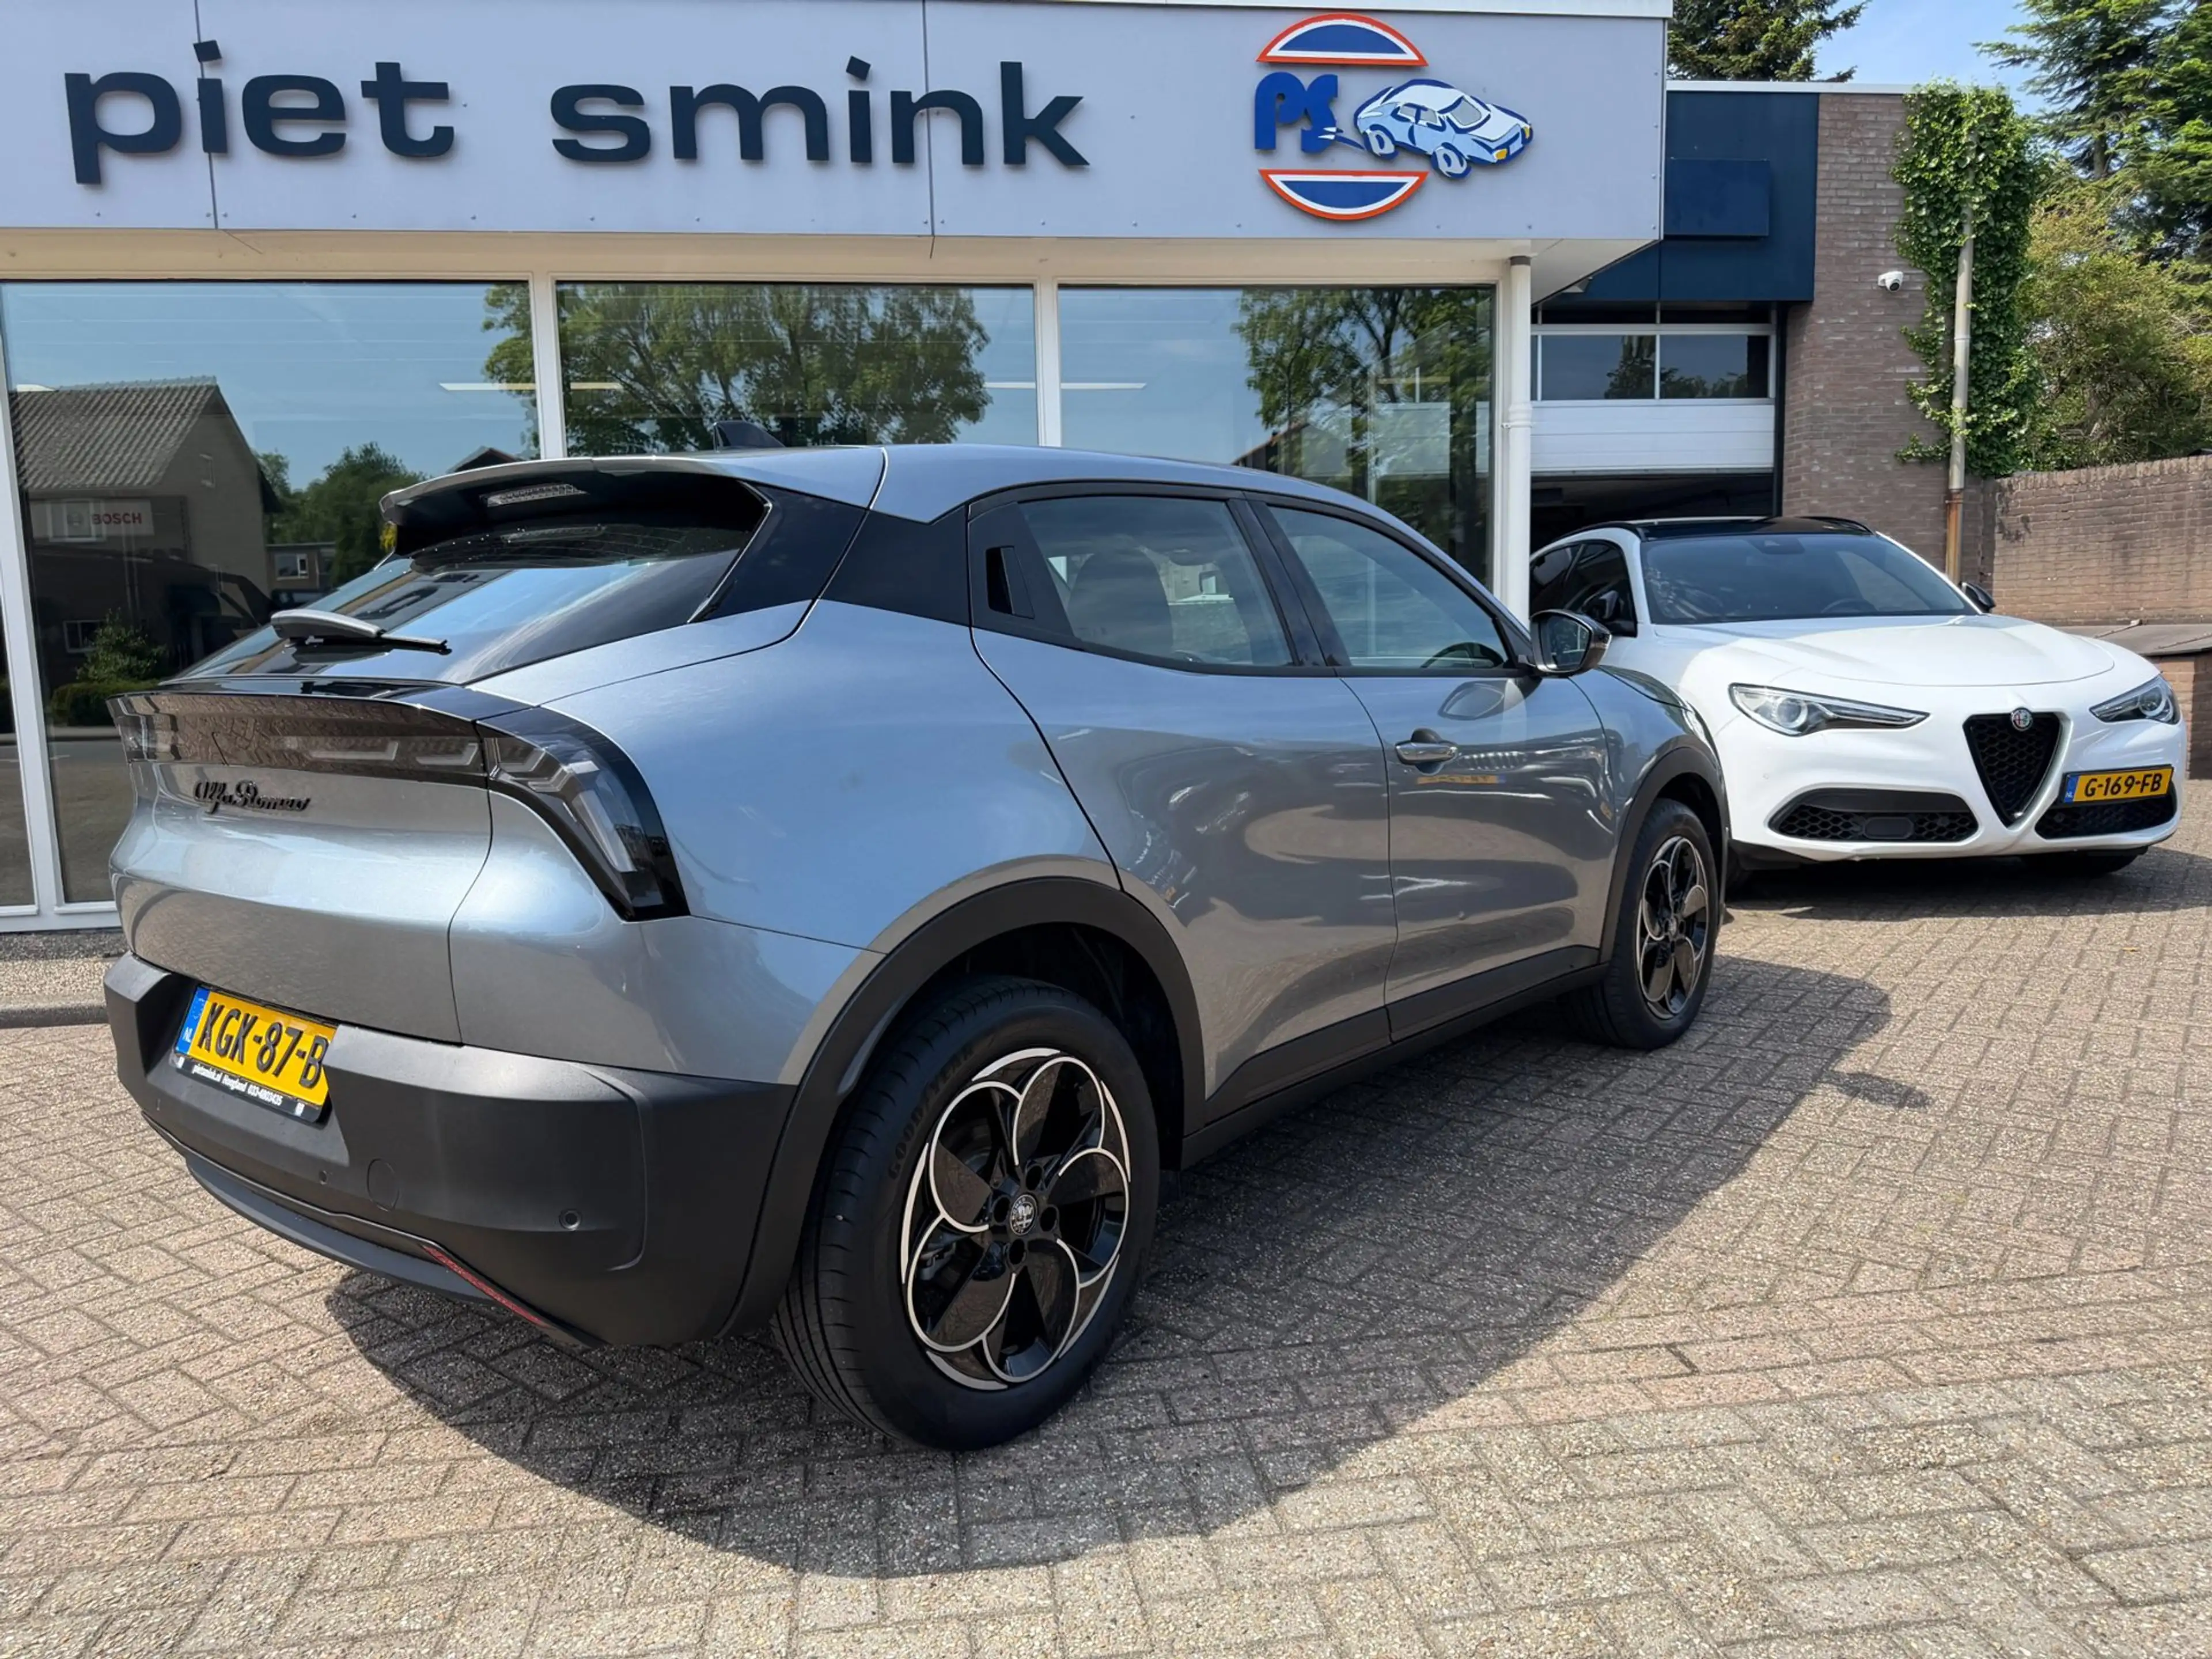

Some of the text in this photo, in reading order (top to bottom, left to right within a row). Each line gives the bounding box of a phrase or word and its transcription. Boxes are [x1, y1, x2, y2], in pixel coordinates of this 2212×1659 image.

[65, 39, 1090, 185] piet smink
[1255, 71, 1339, 153] PS
[92, 512, 142, 525] BOSCH
[194, 779, 311, 814] Alfa Romeo
[2084, 773, 2162, 797] G-169-FB
[198, 1002, 329, 1089] KGK-87-B
